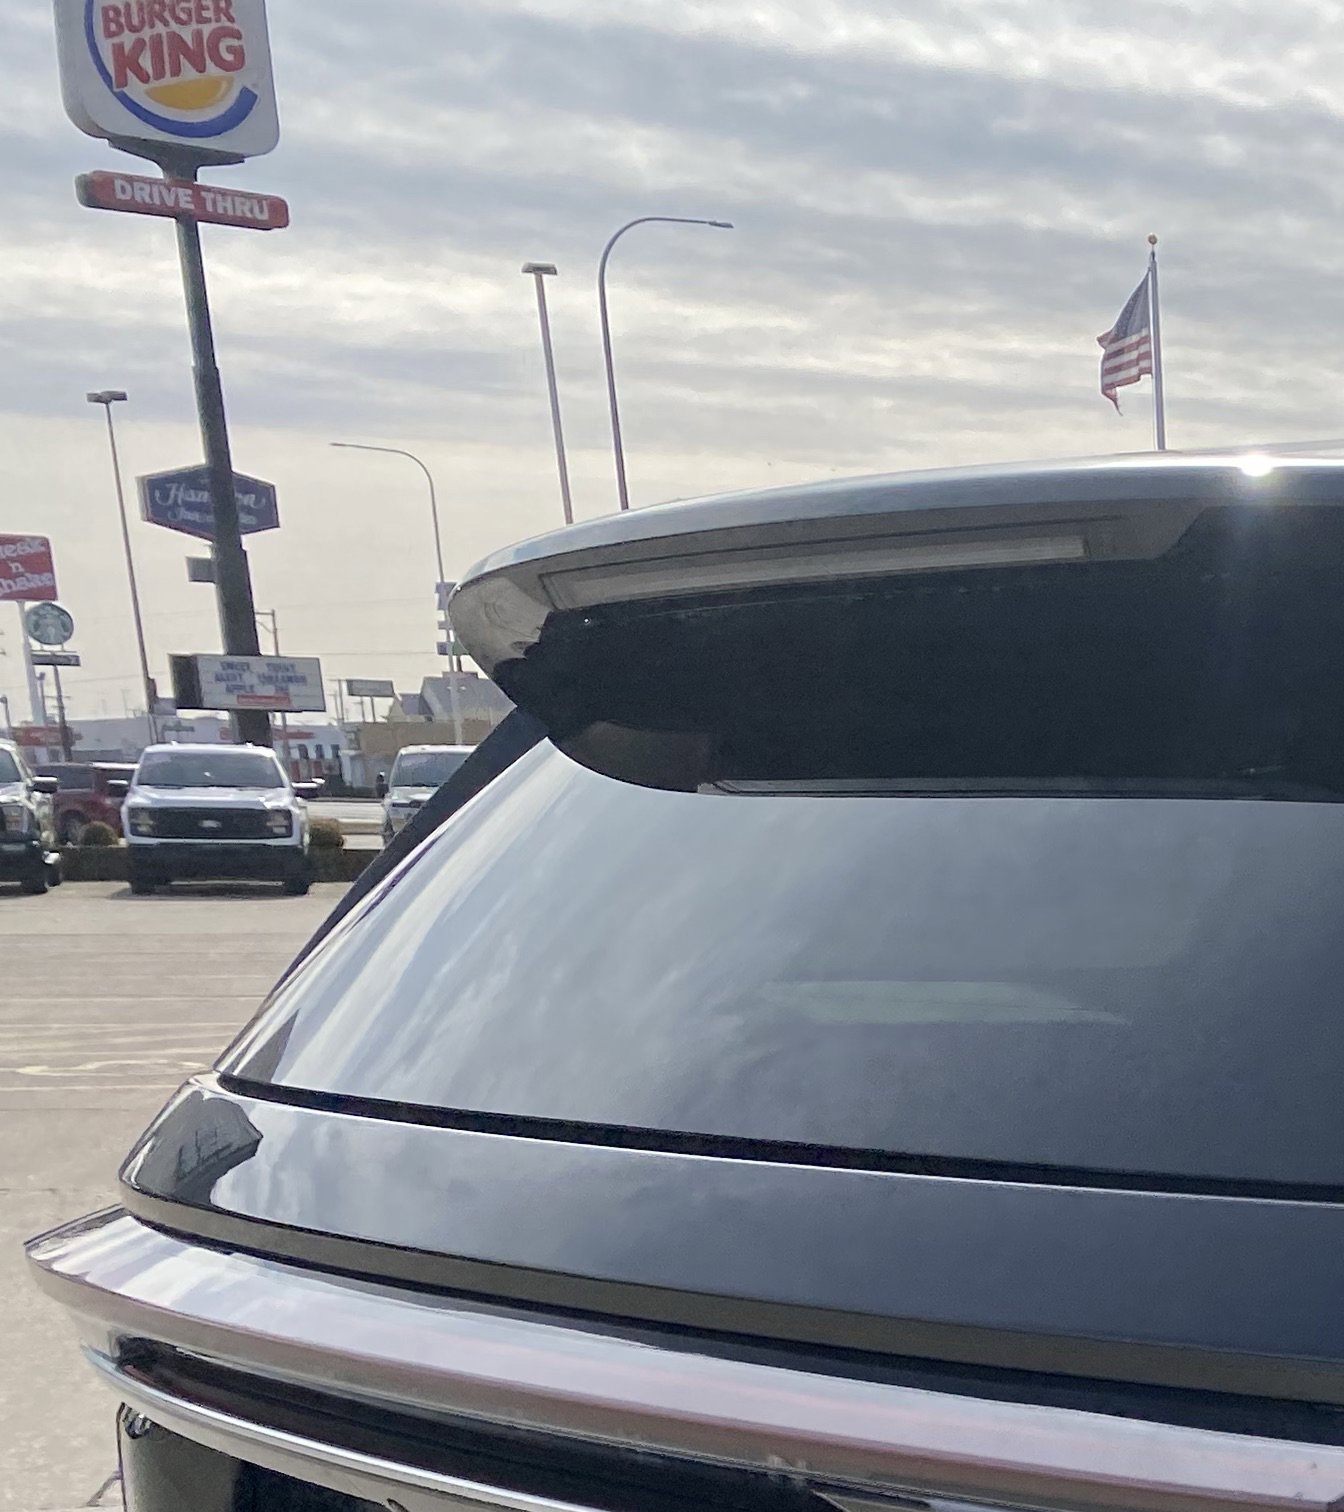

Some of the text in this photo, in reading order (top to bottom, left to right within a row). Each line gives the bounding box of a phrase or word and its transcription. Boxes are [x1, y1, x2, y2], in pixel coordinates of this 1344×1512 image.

[101, 0, 236, 39] BURGER
[111, 26, 246, 89] KING
[114, 179, 269, 220] DRIVE THRU
